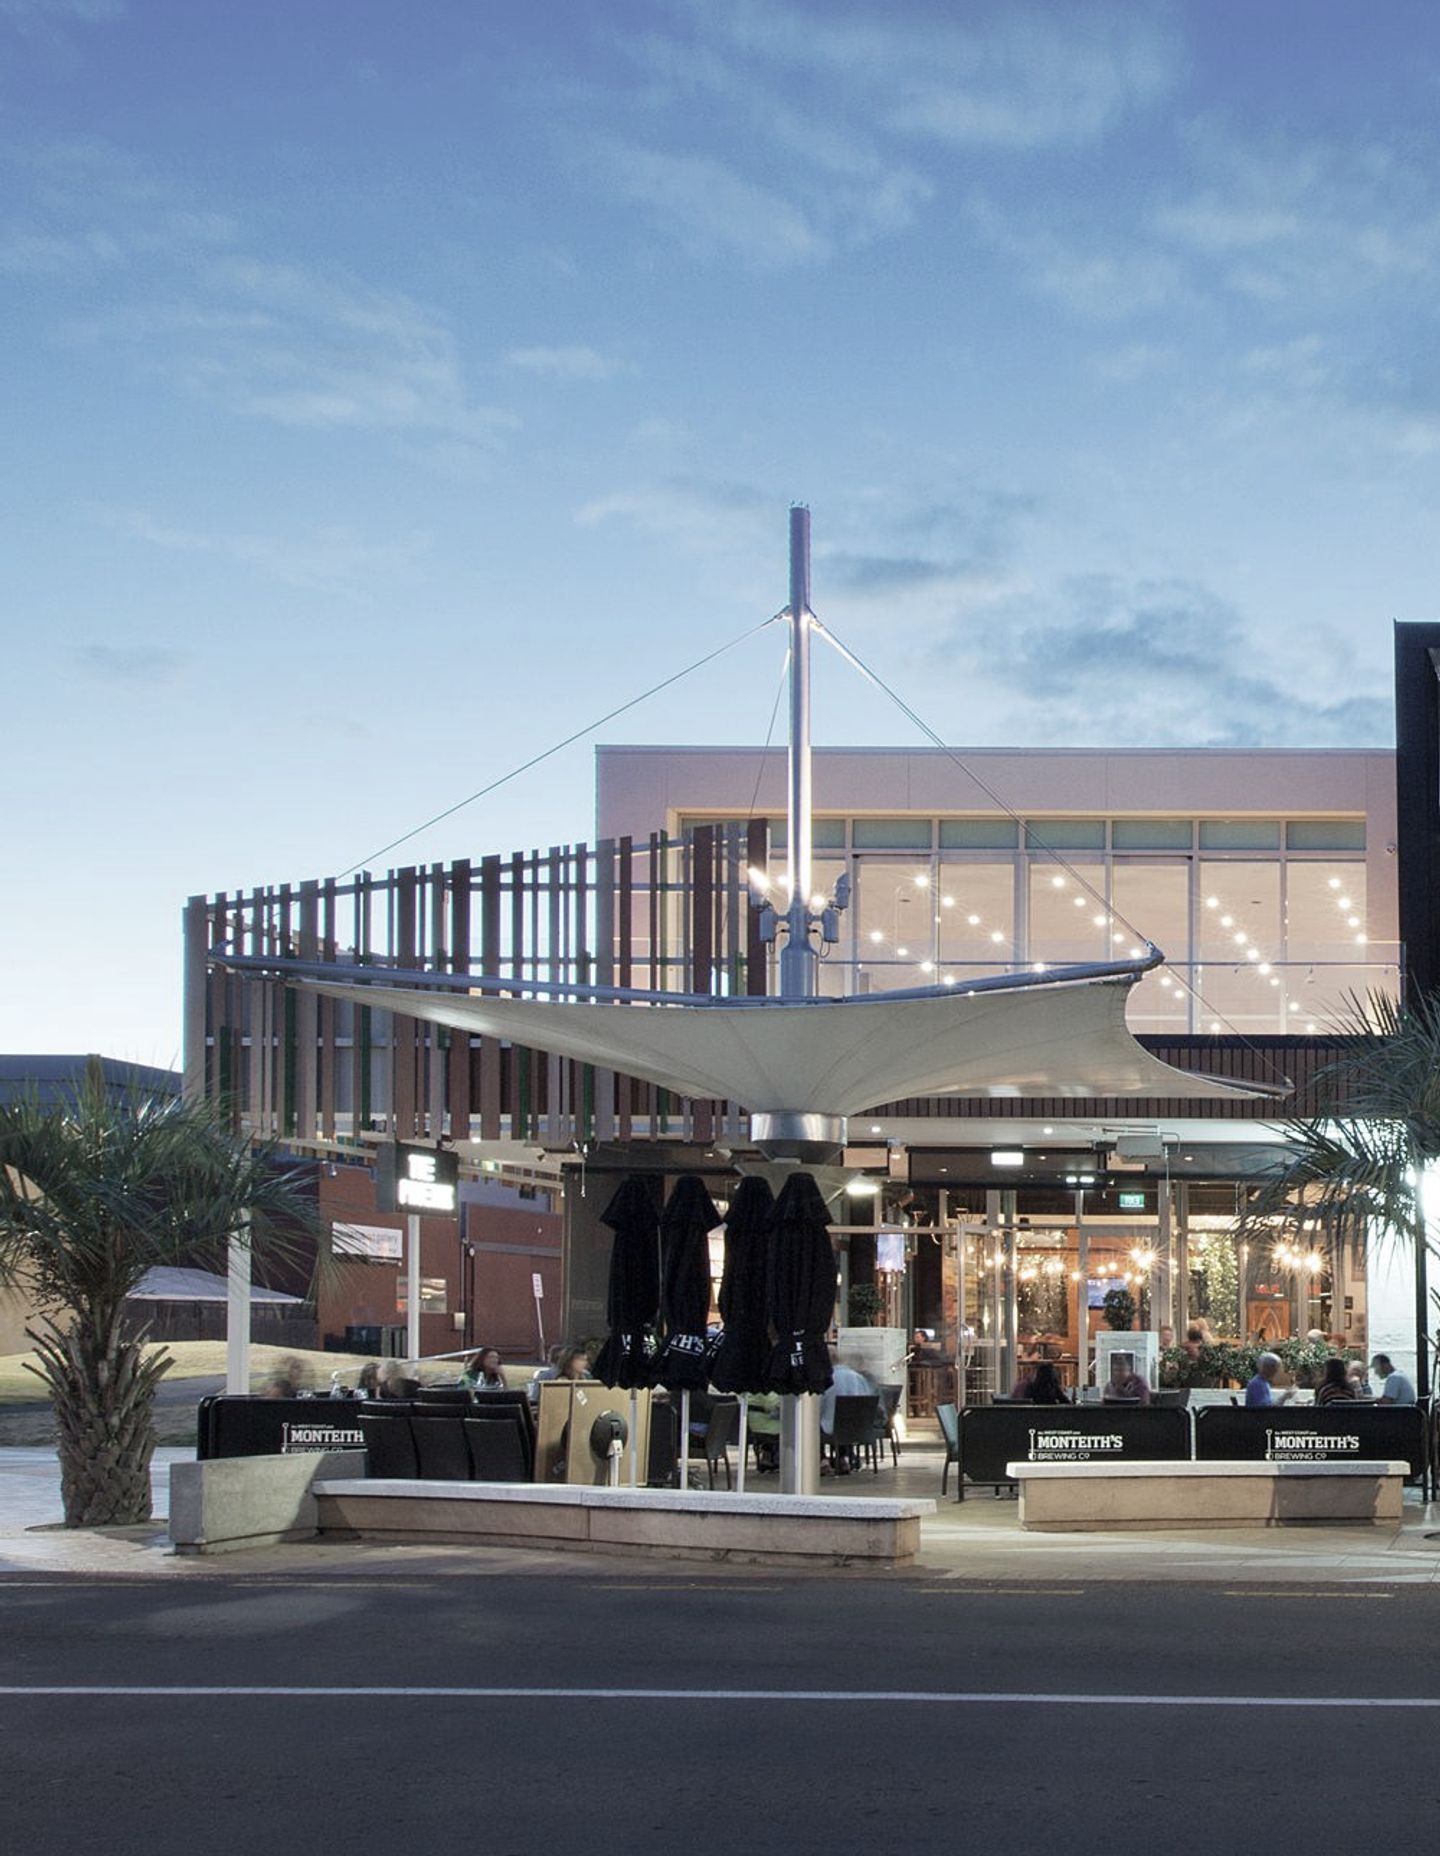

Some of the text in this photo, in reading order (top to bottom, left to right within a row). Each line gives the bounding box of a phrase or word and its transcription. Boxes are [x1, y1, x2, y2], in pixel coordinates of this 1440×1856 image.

[1037, 1434, 1123, 1449] MONTEITH'S
[1274, 1434, 1360, 1449] MONTEITH'S
[1037, 1452, 1077, 1460] BREWING
[1274, 1452, 1313, 1460] BREWING
